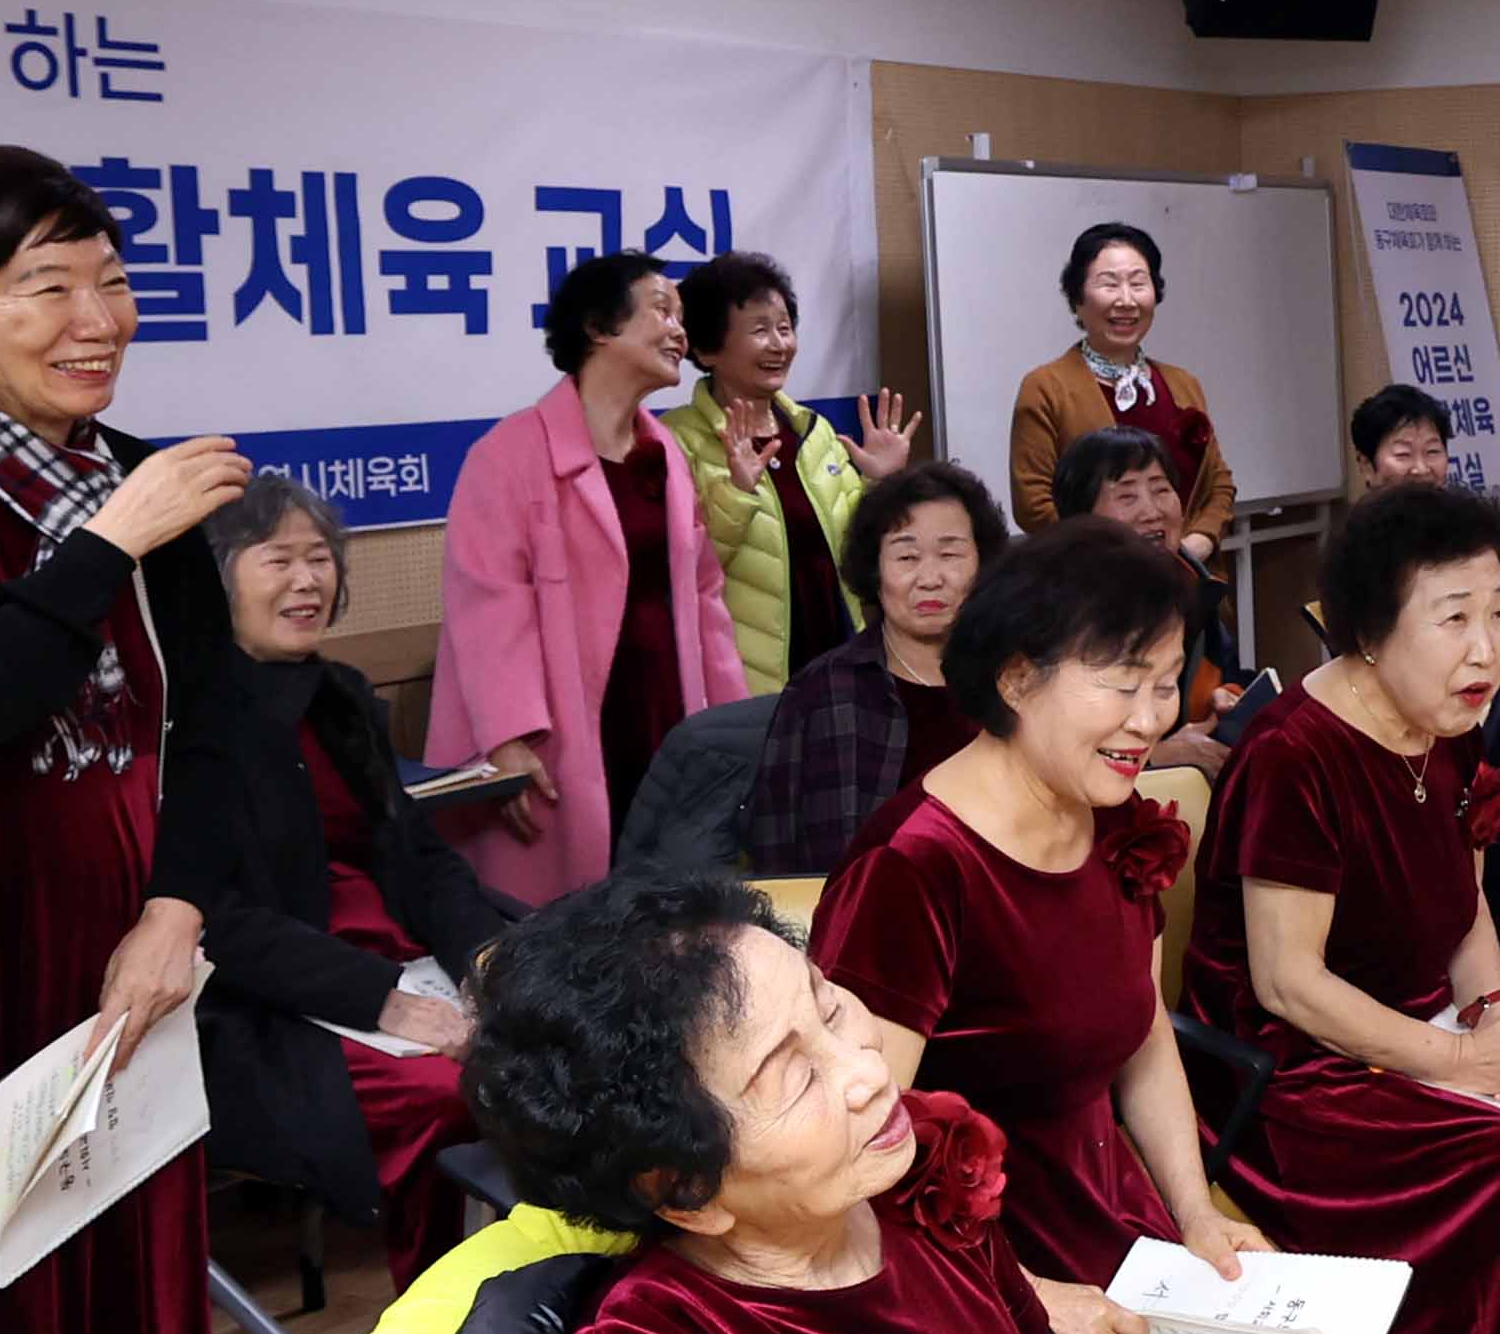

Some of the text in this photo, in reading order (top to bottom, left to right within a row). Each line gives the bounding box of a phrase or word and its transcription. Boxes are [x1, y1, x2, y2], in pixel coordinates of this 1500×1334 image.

[5, 9, 166, 103] 하는
[1399, 291, 1465, 328] 2024
[1411, 343, 1475, 385] 어르신
